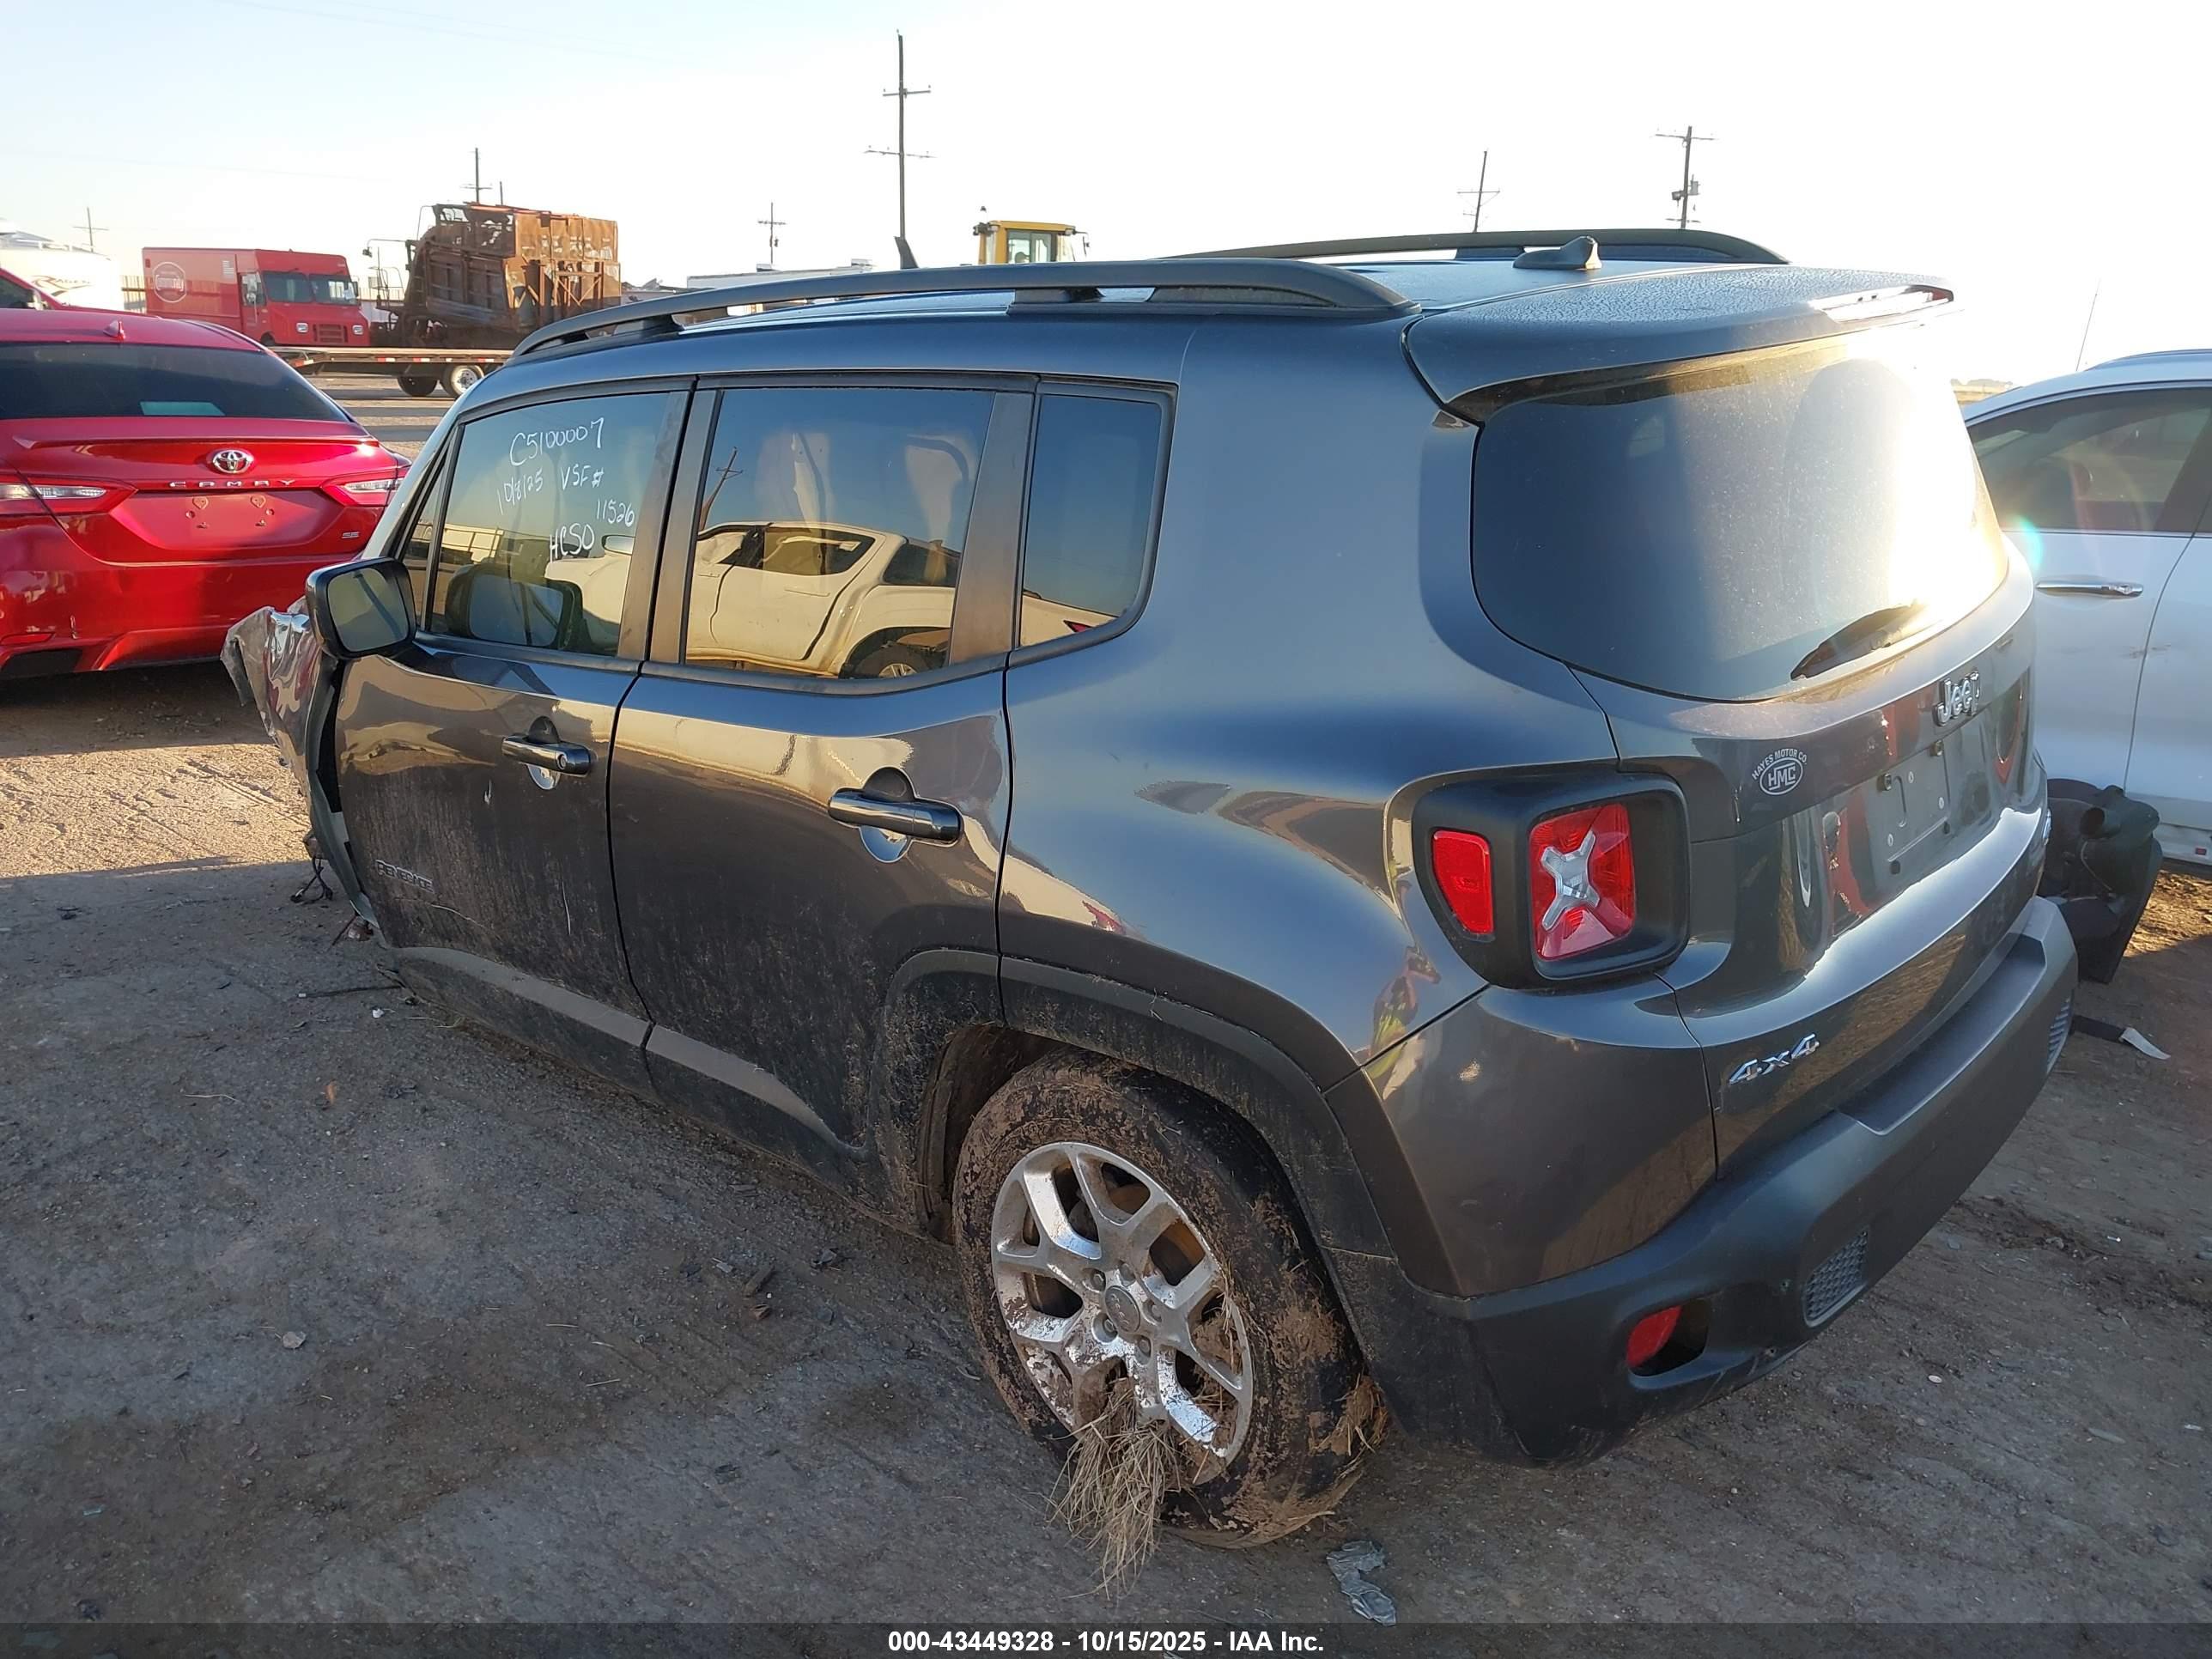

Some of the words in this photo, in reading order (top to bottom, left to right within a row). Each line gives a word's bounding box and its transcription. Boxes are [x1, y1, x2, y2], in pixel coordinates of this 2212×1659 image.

[509, 416, 605, 466] C5100007
[169, 479, 295, 488] CAMRY
[596, 498, 635, 527] 11526
[550, 522, 595, 564] HCSO
[1934, 672, 1980, 726] Jeep
[1752, 754, 1774, 781] HAYES
[1774, 748, 1798, 760] MOTOR
[1768, 762, 1796, 791] HMC
